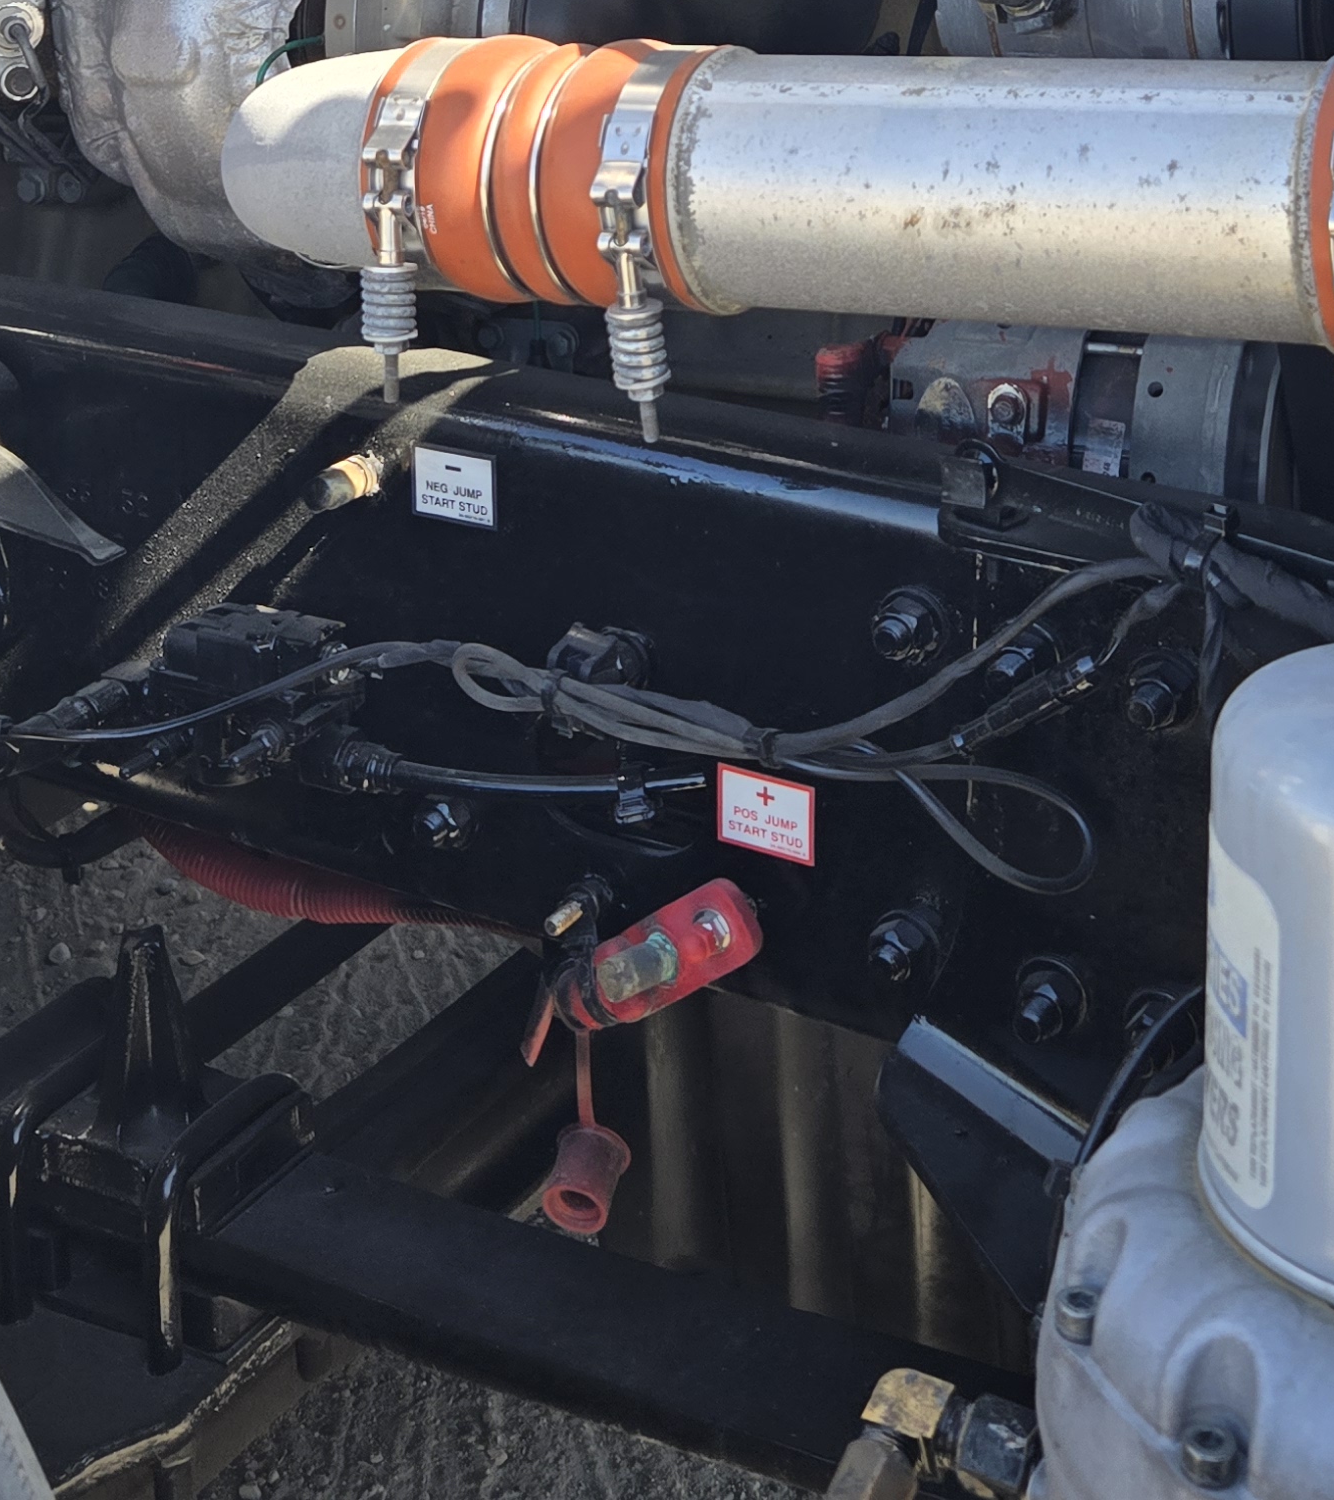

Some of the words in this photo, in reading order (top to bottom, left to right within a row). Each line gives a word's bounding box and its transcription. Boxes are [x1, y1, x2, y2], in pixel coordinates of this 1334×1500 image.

[426, 480, 448, 493] NEG
[453, 486, 482, 499] JUMP
[421, 493, 455, 509] START
[458, 501, 488, 516] STUD
[733, 805, 758, 821] POS
[764, 814, 798, 831] JUMP
[728, 819, 767, 839] START
[770, 831, 803, 849] STUD
